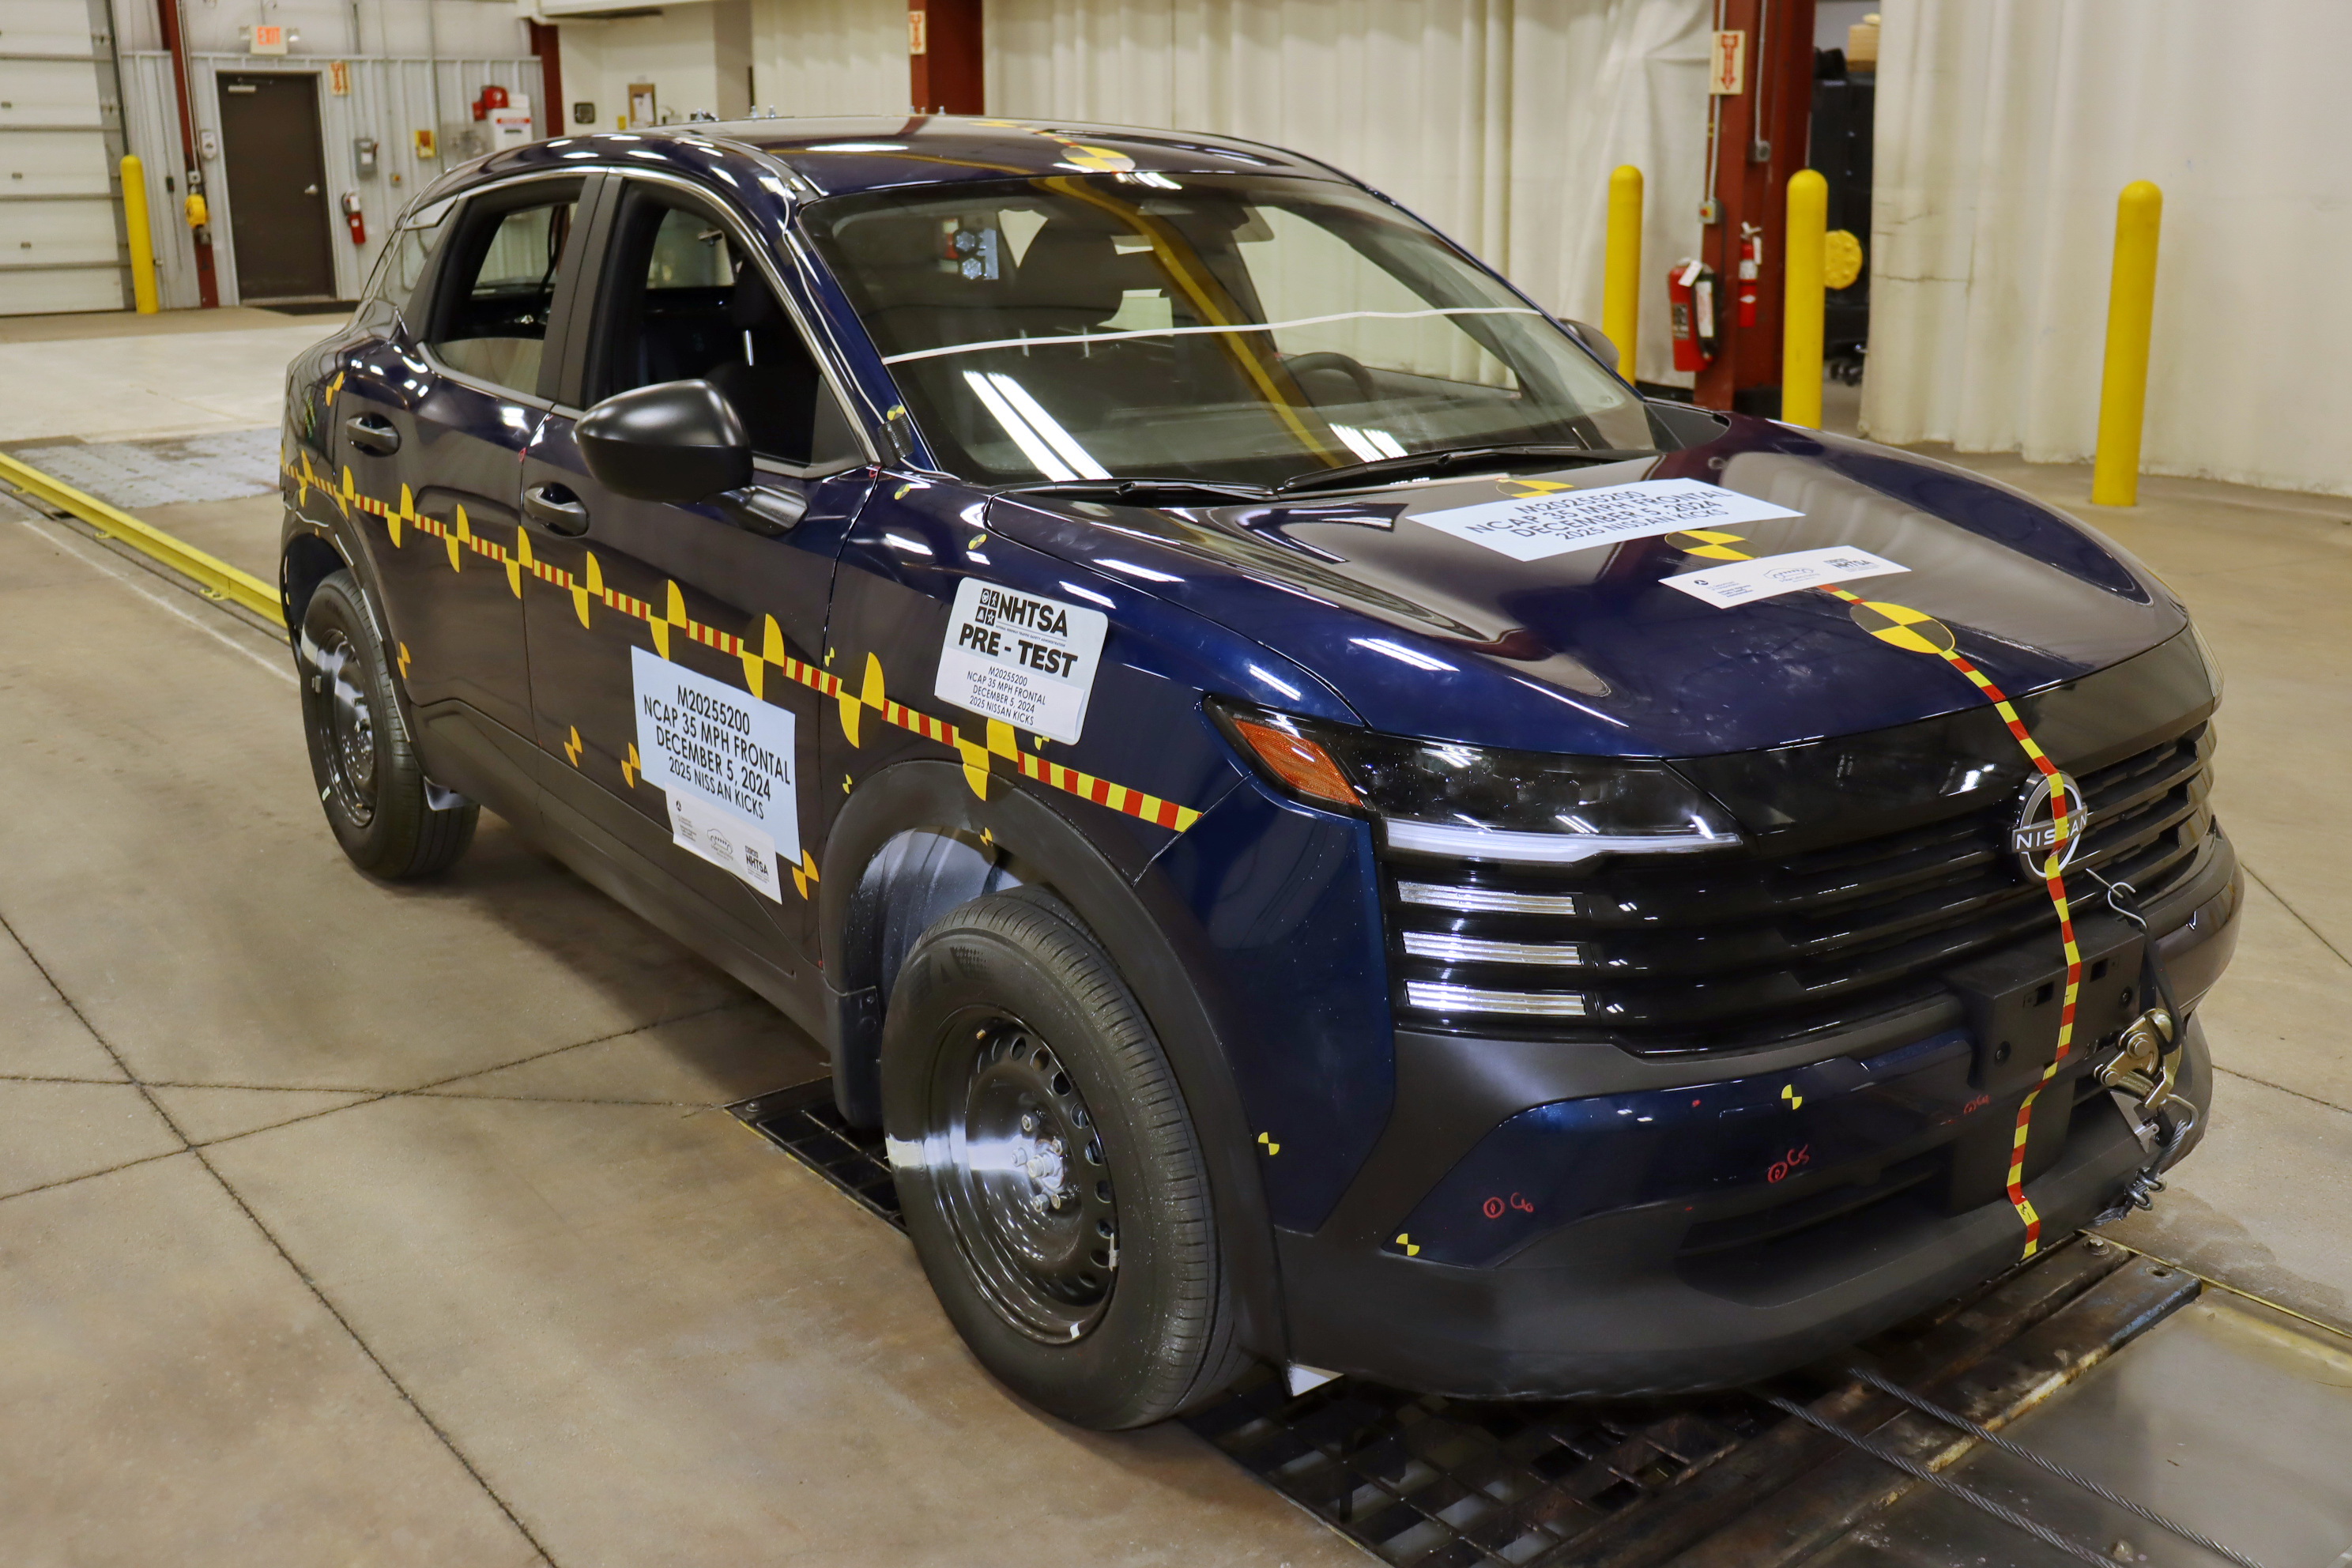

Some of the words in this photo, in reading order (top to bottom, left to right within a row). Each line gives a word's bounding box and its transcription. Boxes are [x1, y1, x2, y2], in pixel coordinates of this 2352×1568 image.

[257, 26, 281, 45] EXIT
[1464, 515, 1540, 533] NCAP
[1543, 510, 1578, 519] 35
[1575, 502, 1635, 514] MPH
[1632, 491, 1733, 507] FRONTAL
[1510, 511, 1640, 537] DECEMBER
[1664, 500, 1722, 512] 2024
[1514, 491, 1646, 514] M20255200
[1555, 527, 1605, 540] 2025
[1602, 516, 1676, 531] NISSAN
[1672, 509, 1728, 520] KICKS
[998, 594, 1068, 637] NHTSA
[959, 623, 1001, 657] PRE
[1018, 639, 1078, 678] TEST
[967, 670, 987, 684] NCAP
[987, 677, 996, 688] 35
[997, 681, 1013, 694] MPH
[1014, 686, 1046, 706] FRONTAL
[988, 666, 1028, 687] M20255200
[677, 684, 750, 737] M20255200
[969, 695, 985, 708] 2025
[986, 700, 1012, 718] NISSAN
[1012, 710, 1034, 726] KICKS
[973, 684, 1008, 705] DECEMBER
[1009, 697, 1016, 709] 5,
[1017, 699, 1035, 714] 2024
[644, 694, 678, 729] NCAP
[682, 712, 696, 738] 35
[701, 721, 729, 754] MPH
[734, 735, 790, 786] FRONTAL
[656, 725, 722, 776] DECEMBER
[741, 766, 771, 801] 2024
[669, 756, 692, 782] 2025
[694, 768, 732, 803] NISSAN
[735, 789, 764, 820] KICKS
[2016, 810, 2087, 850] NISAN
[745, 854, 769, 876] NHTSA
